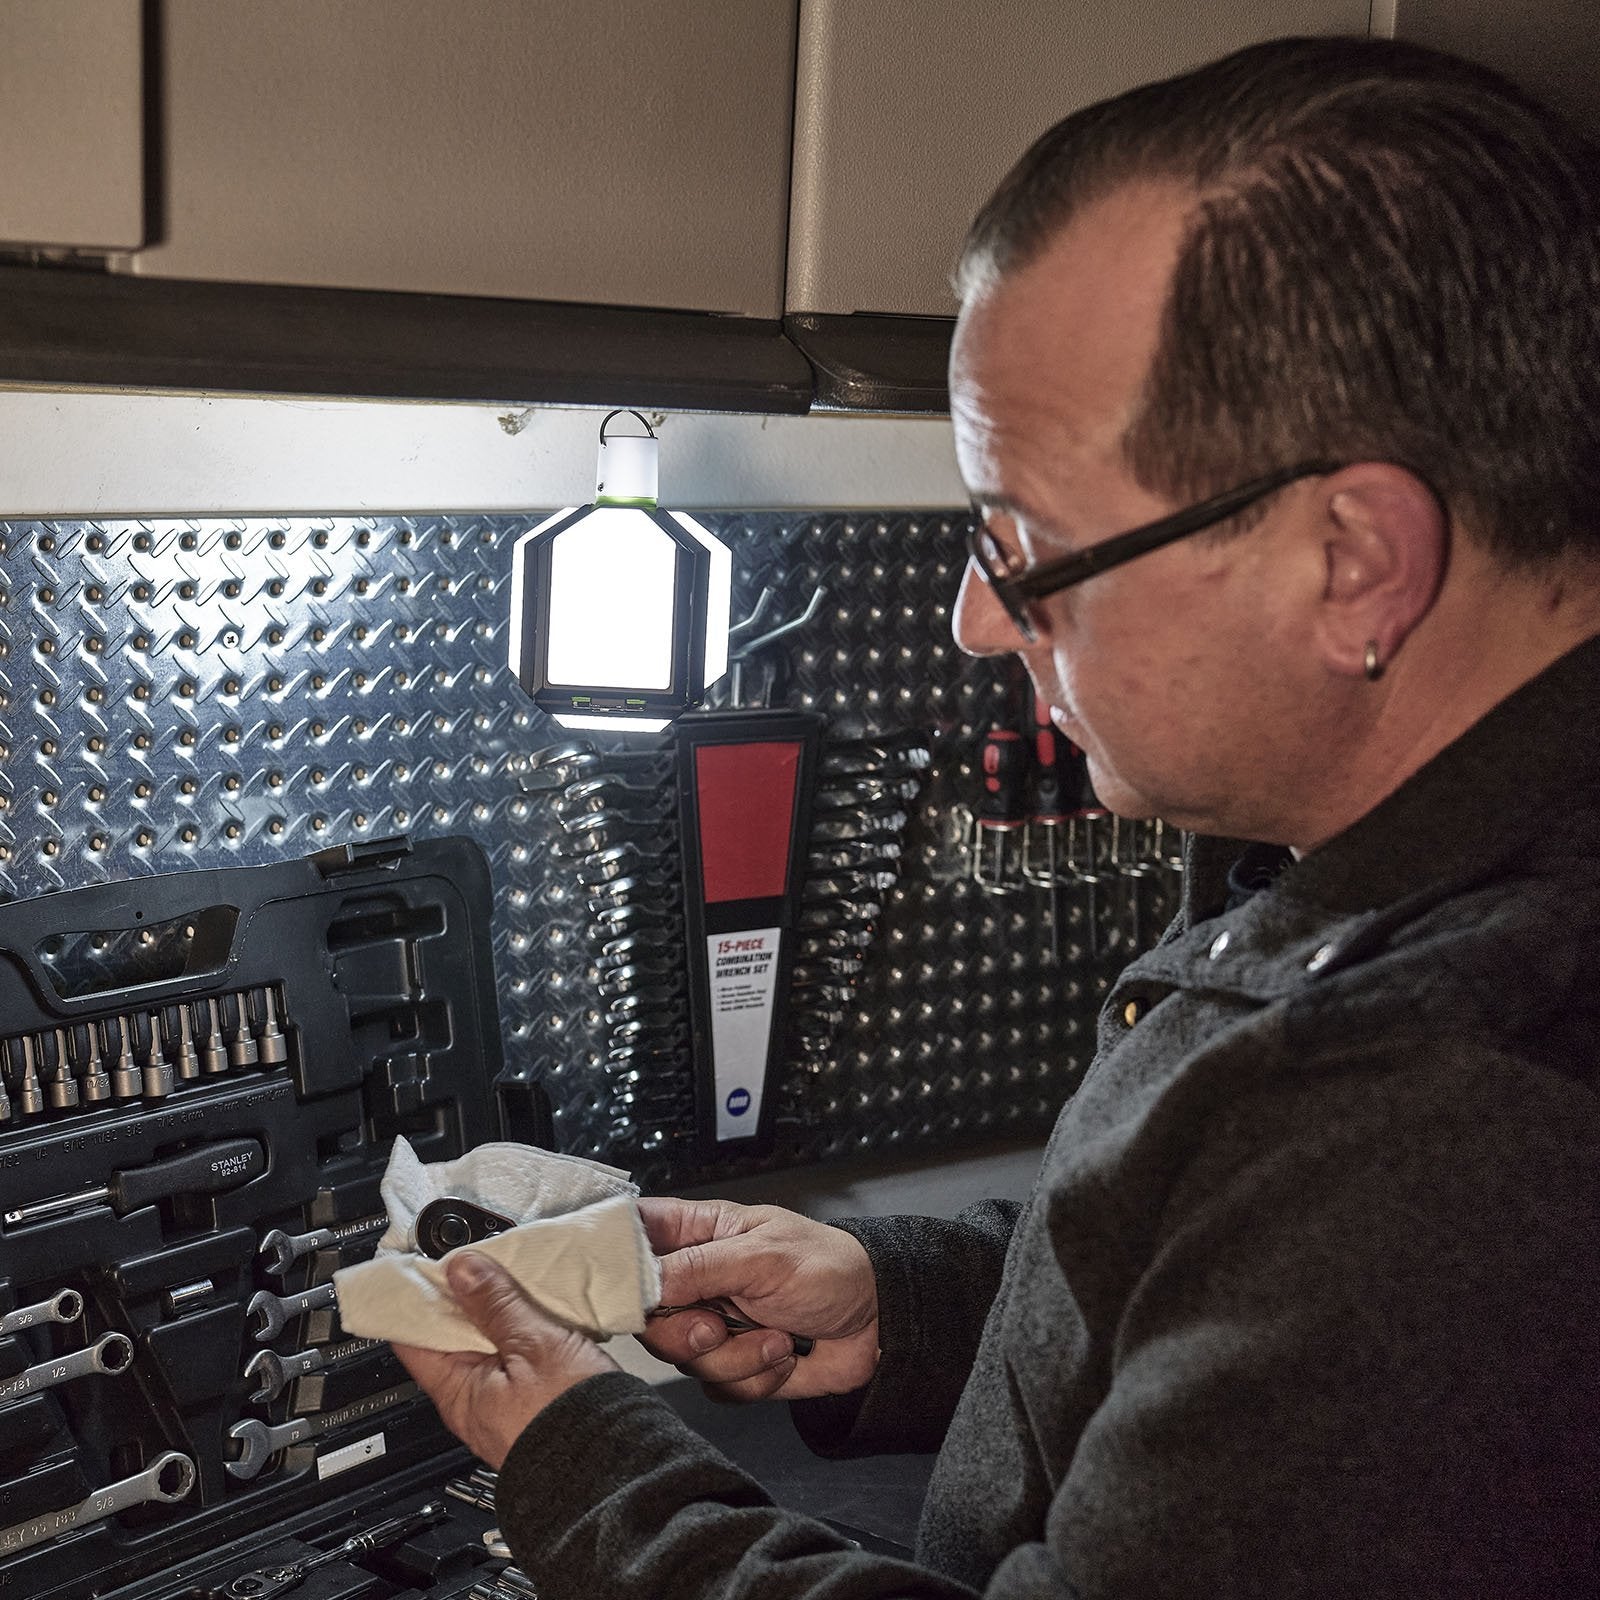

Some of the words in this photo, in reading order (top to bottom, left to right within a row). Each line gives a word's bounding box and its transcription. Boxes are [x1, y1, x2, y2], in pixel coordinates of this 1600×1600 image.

[718, 938, 764, 954] 15-PIECE
[716, 952, 773, 967] COMBINATION
[716, 966, 751, 979] WRENCH
[753, 964, 769, 975] SET
[211, 1151, 253, 1171] STANLEY
[221, 1163, 247, 1177] 92-814
[334, 1222, 369, 1239] STANLEY
[52, 1366, 67, 1379] 1/2
[96, 1496, 114, 1512] 5/8
